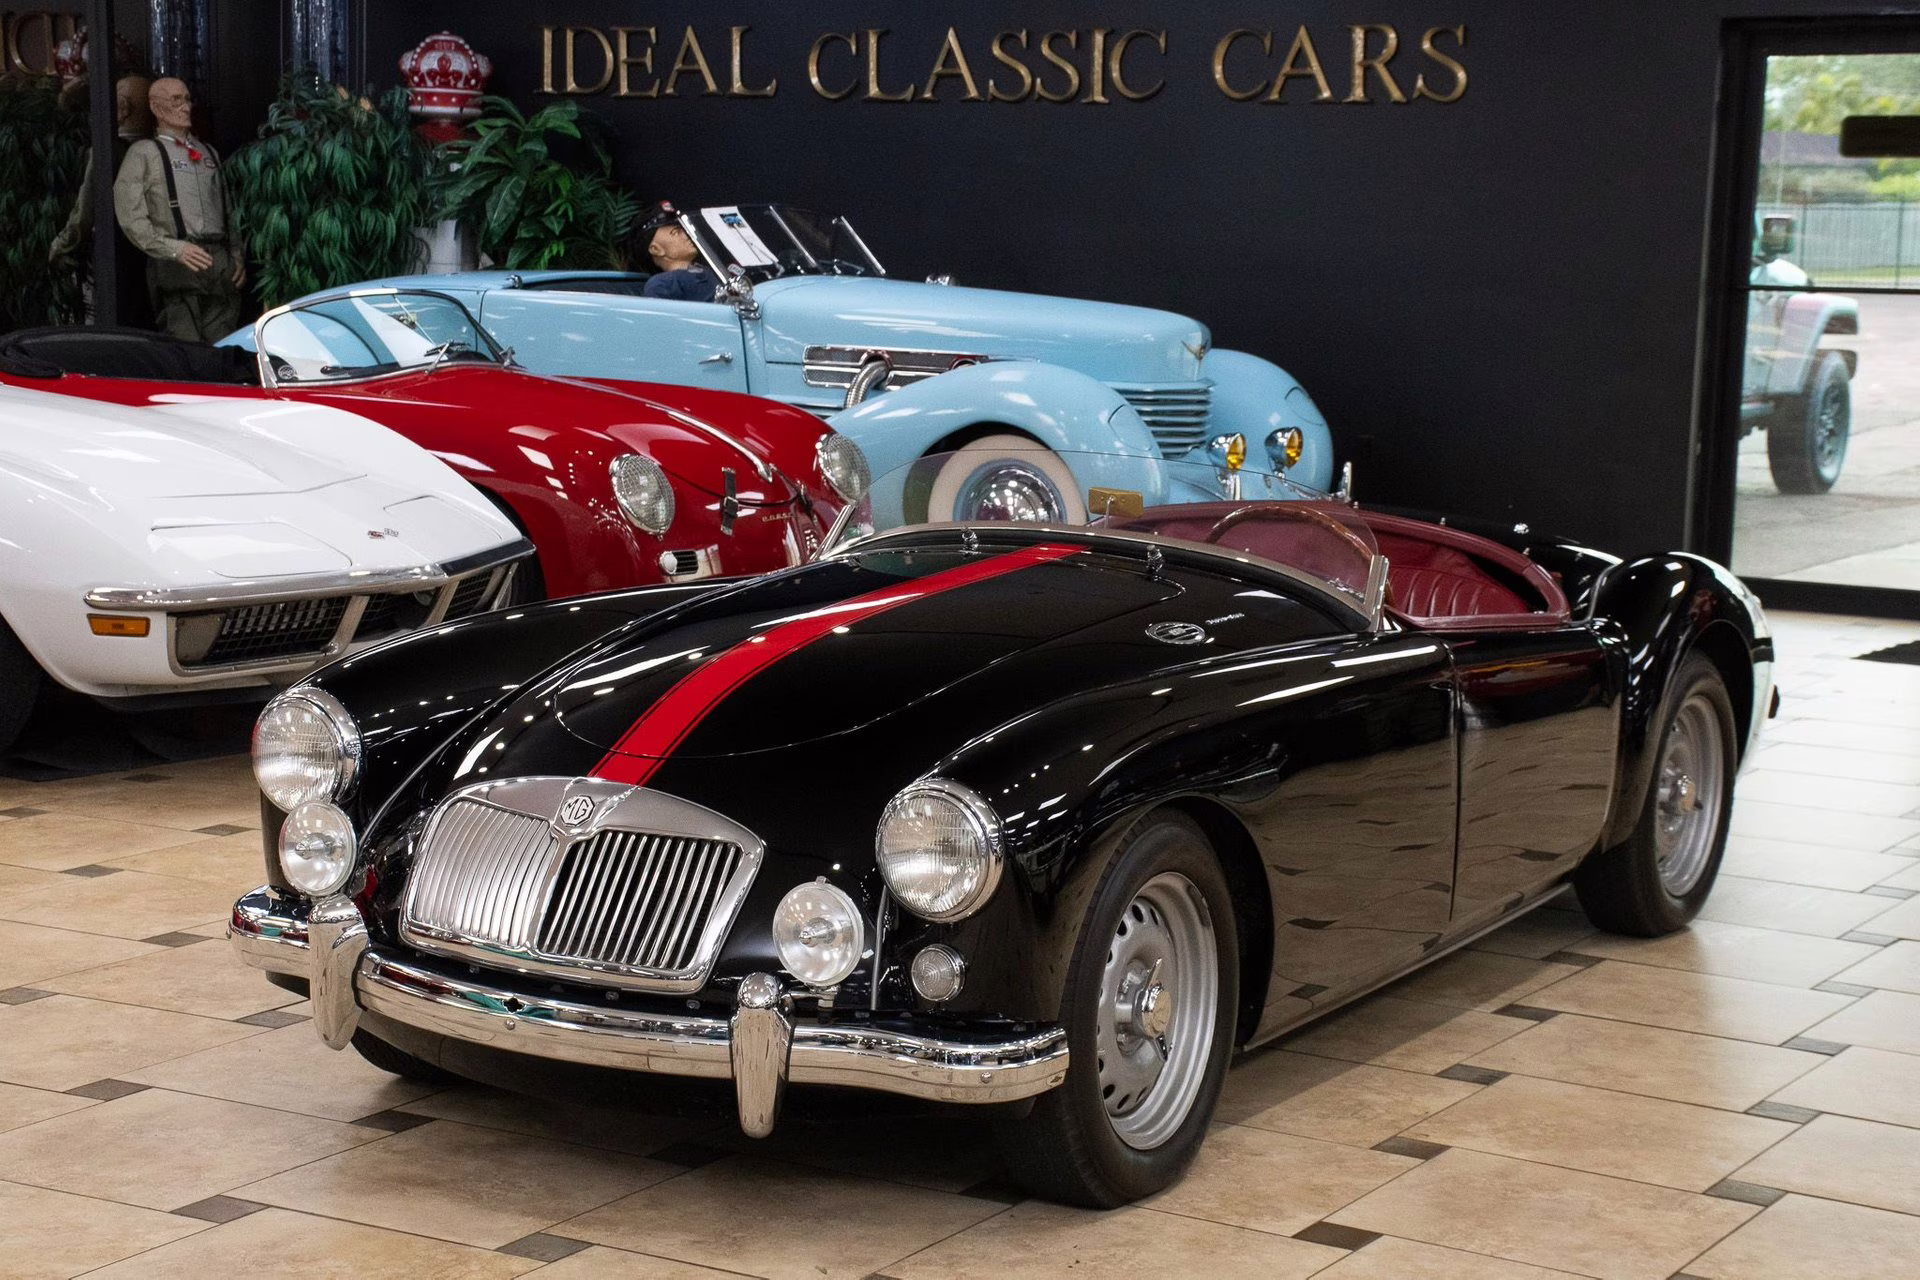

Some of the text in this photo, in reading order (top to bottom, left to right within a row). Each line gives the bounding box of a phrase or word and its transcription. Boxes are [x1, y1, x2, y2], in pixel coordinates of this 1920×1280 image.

[536, 24, 1467, 103] IDEAL CLASSIC CARS
[564, 798, 589, 820] MG
